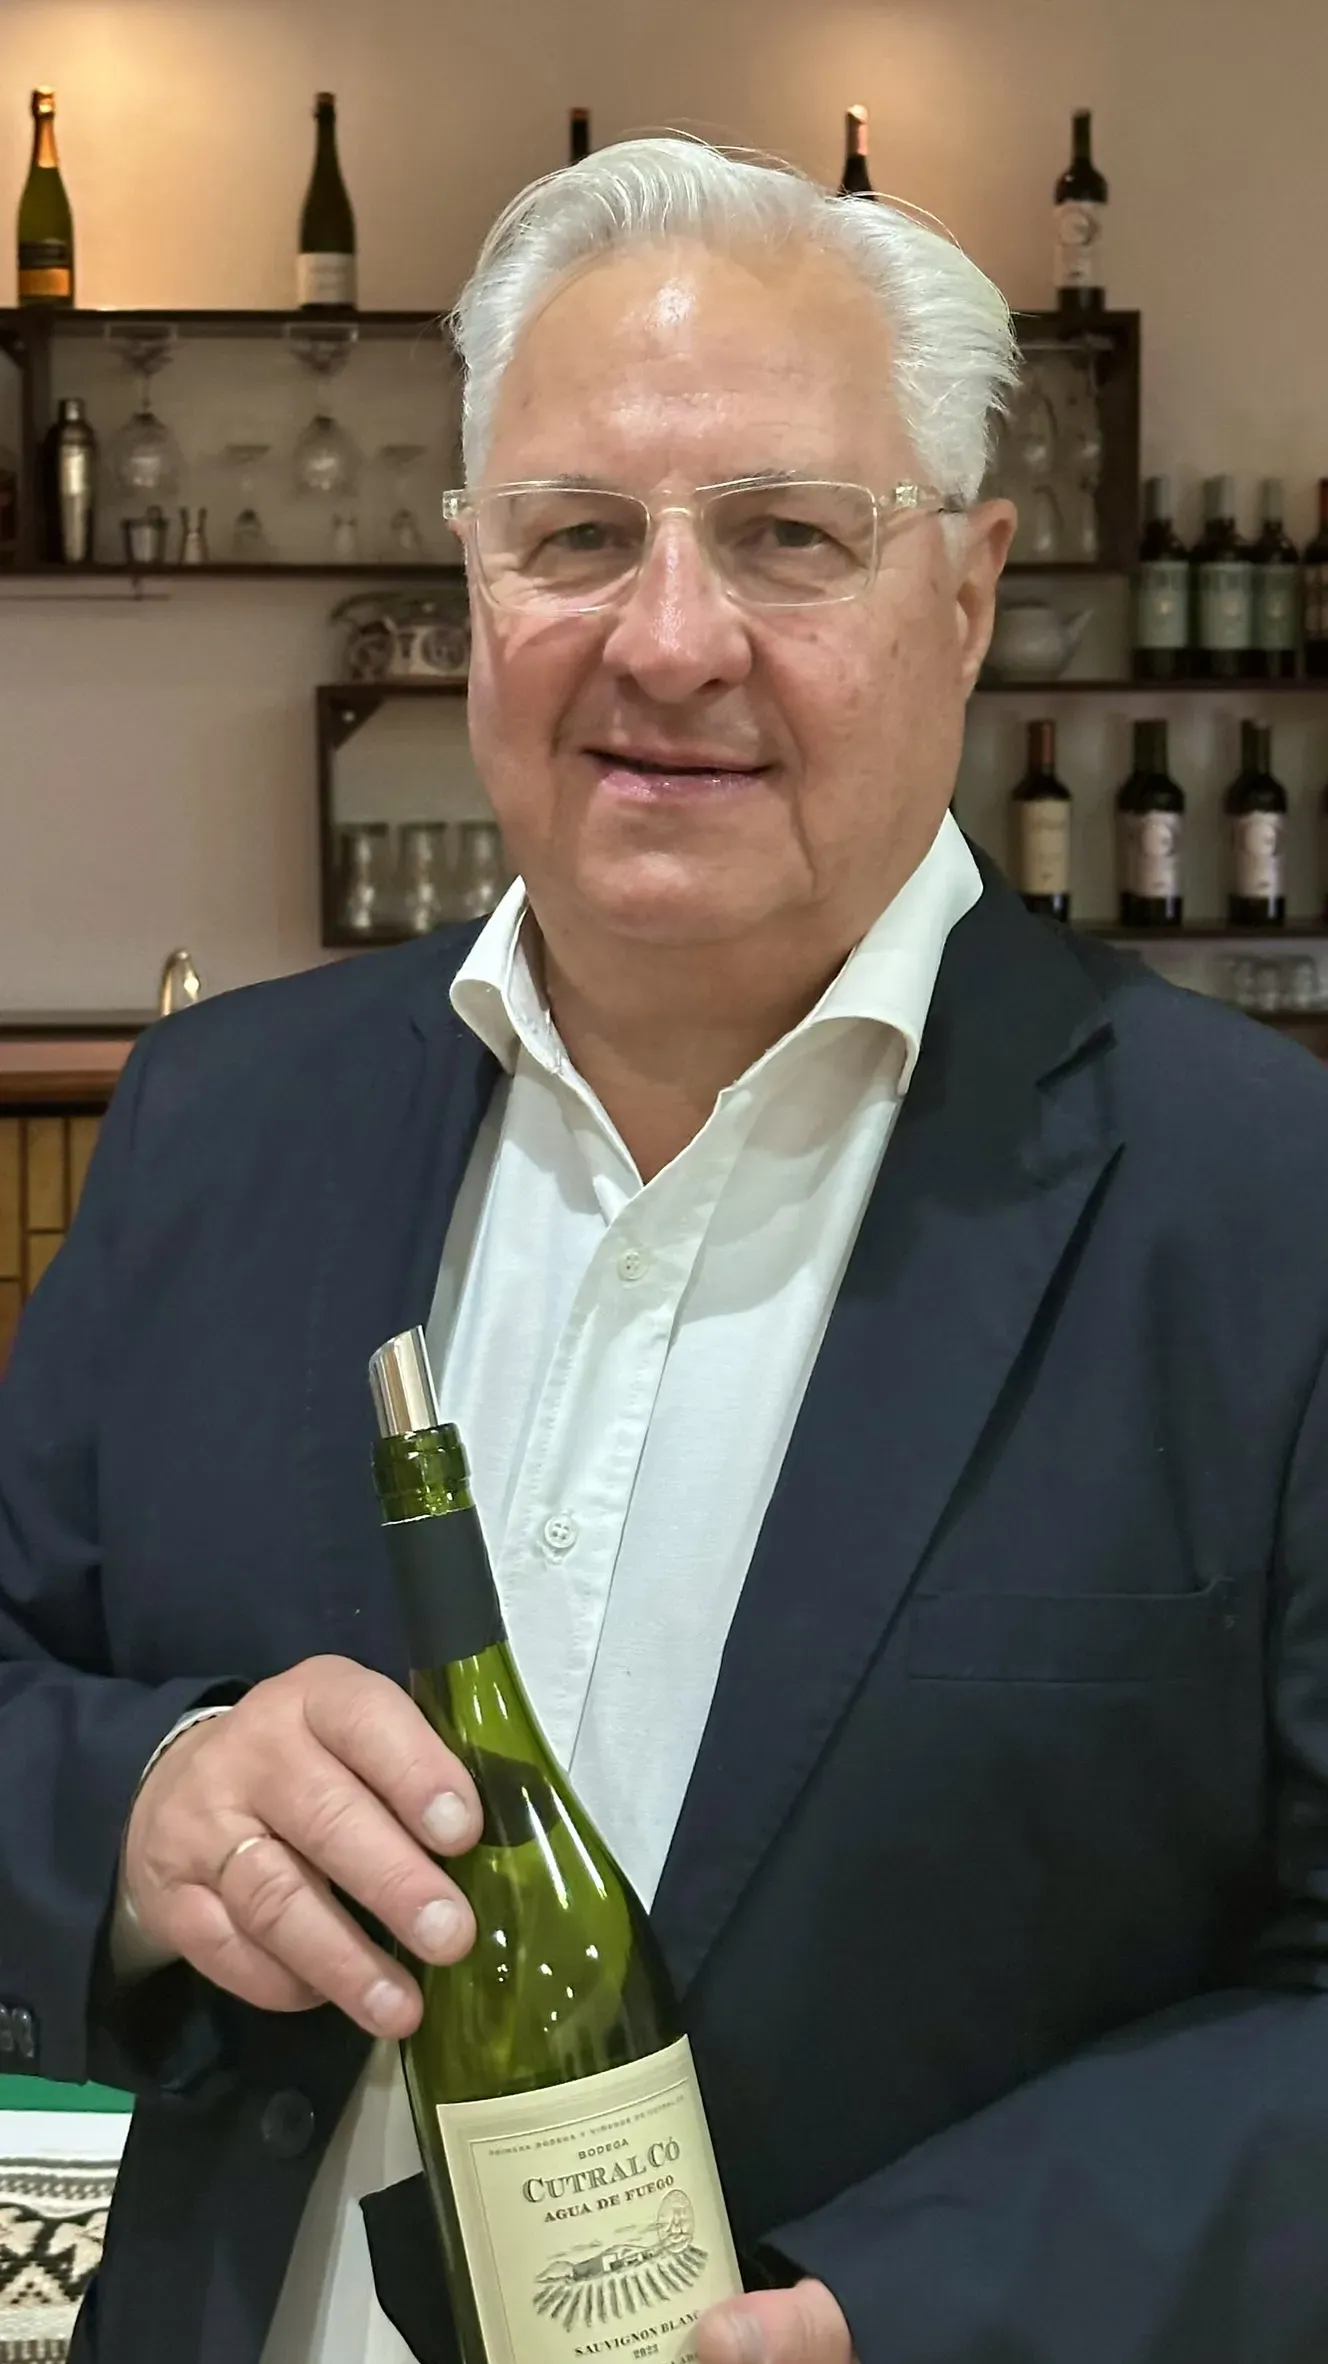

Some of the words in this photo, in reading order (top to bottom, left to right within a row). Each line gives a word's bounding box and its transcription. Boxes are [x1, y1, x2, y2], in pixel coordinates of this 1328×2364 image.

[578, 2138, 630, 2160] BODEGA
[522, 2155, 647, 2204] CUTRAL
[647, 2136, 681, 2168] CÓ
[544, 2203, 592, 2223] AGUA
[597, 2194, 621, 2211] DE
[625, 2174, 675, 2202] FUEGO
[574, 2326, 659, 2356] SAUVIGNON
